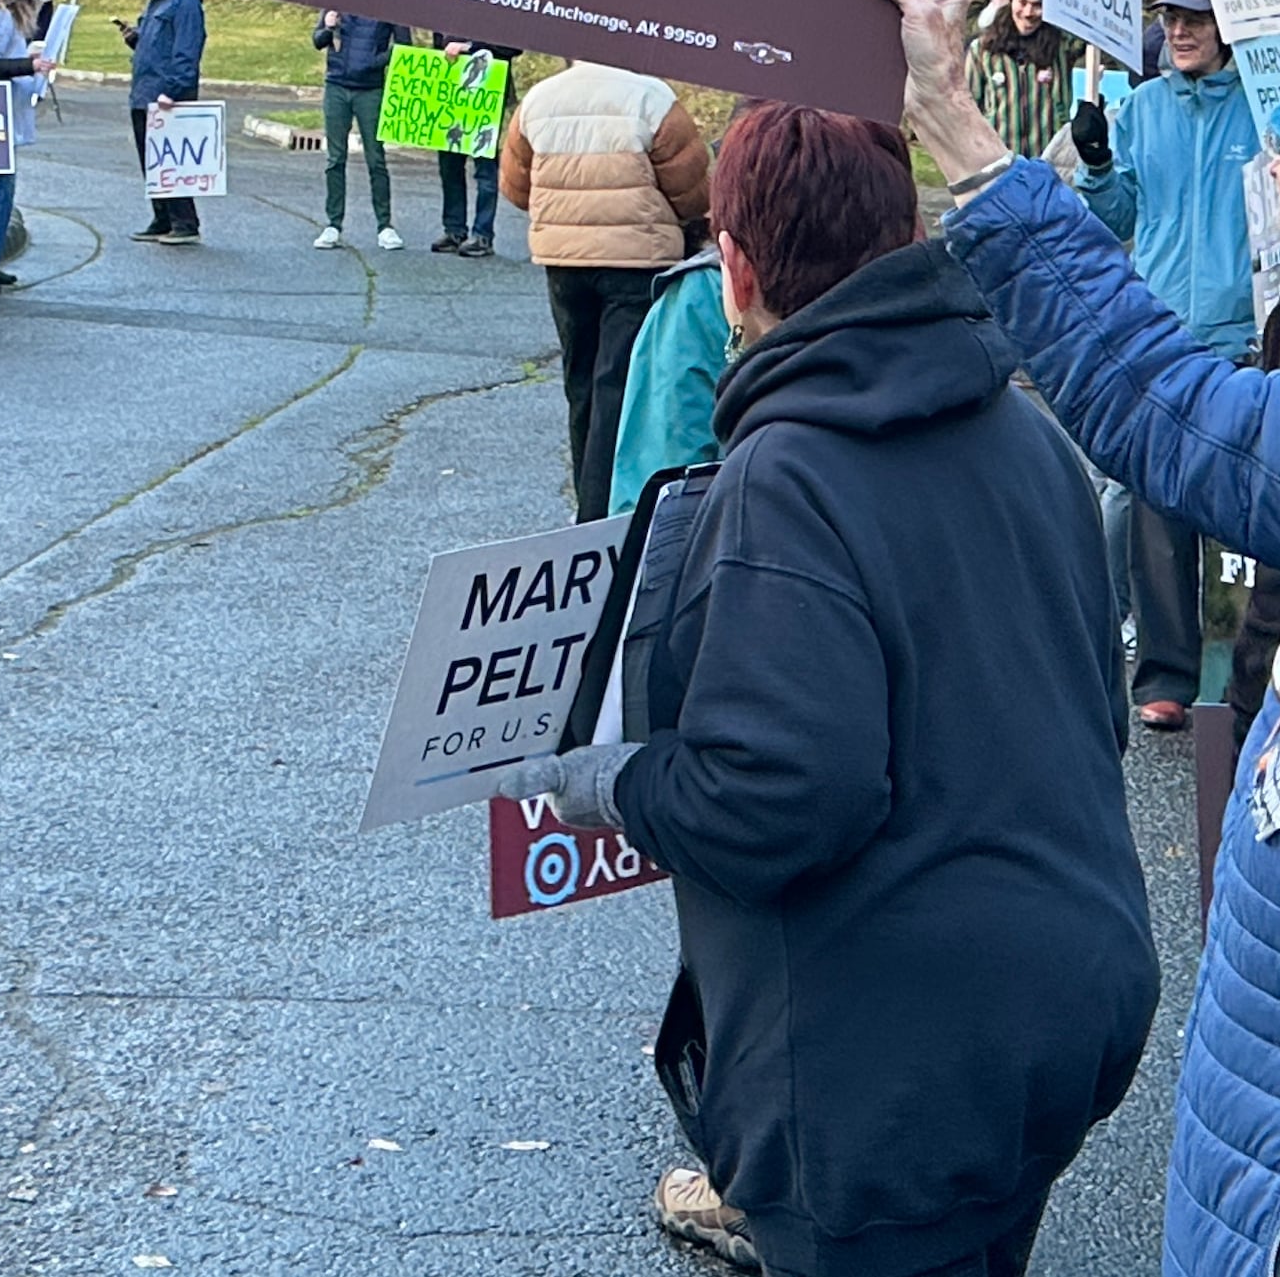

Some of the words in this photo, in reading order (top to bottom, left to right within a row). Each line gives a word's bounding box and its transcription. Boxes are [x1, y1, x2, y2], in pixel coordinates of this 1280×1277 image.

[542, 0, 633, 33] Anchorage,
[636, 20, 661, 37] AK
[663, 25, 717, 49] 99509
[393, 53, 453, 79] MARY
[389, 74, 434, 97] EVEN
[384, 94, 455, 130] SHOWS
[462, 113, 492, 135] UP
[380, 119, 434, 146] MORE!
[148, 135, 208, 170] DAN
[161, 168, 217, 191] Energy
[436, 632, 586, 716] PELT
[421, 726, 483, 762] FOR
[501, 712, 558, 743] U.S.
